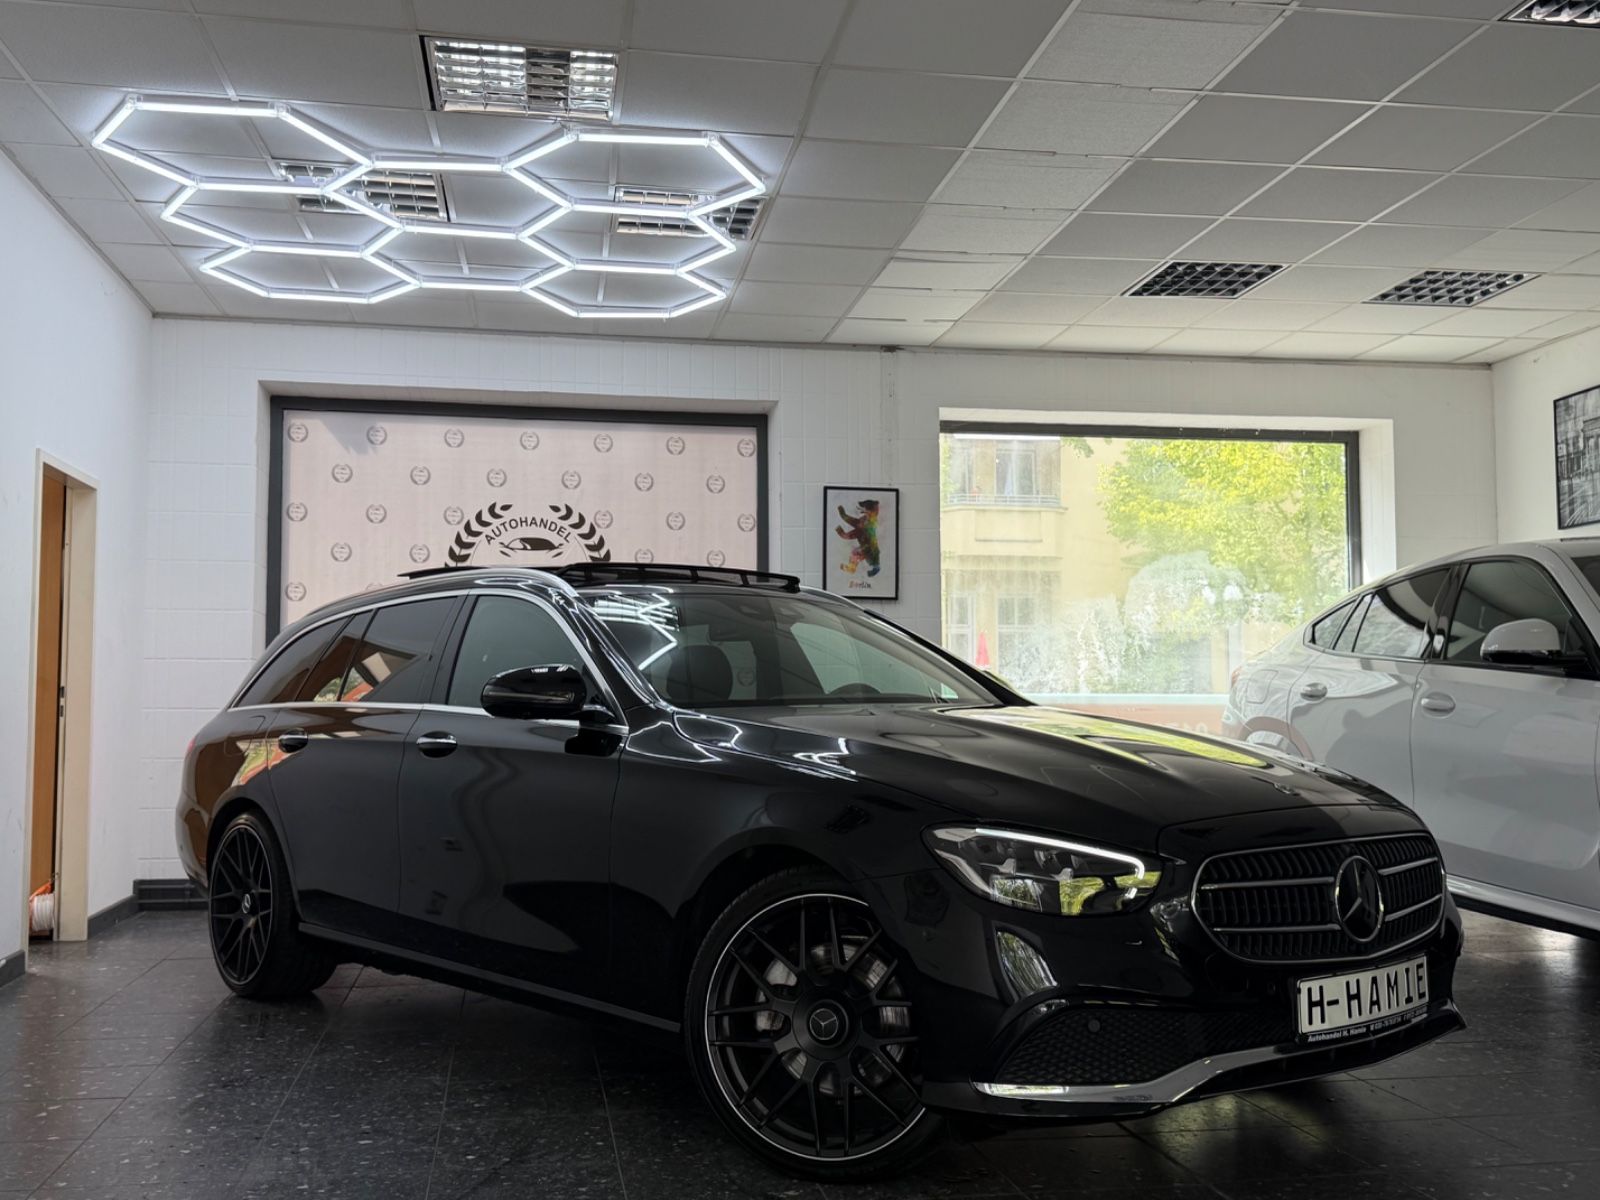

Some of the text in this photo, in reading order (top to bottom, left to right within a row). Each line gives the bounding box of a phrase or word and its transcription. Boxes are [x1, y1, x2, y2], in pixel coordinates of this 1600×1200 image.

[485, 516, 571, 545] AUTOHANDEL
[1307, 963, 1426, 1026] H-HAMIE
[1308, 1031, 1342, 1042] Autohandel
